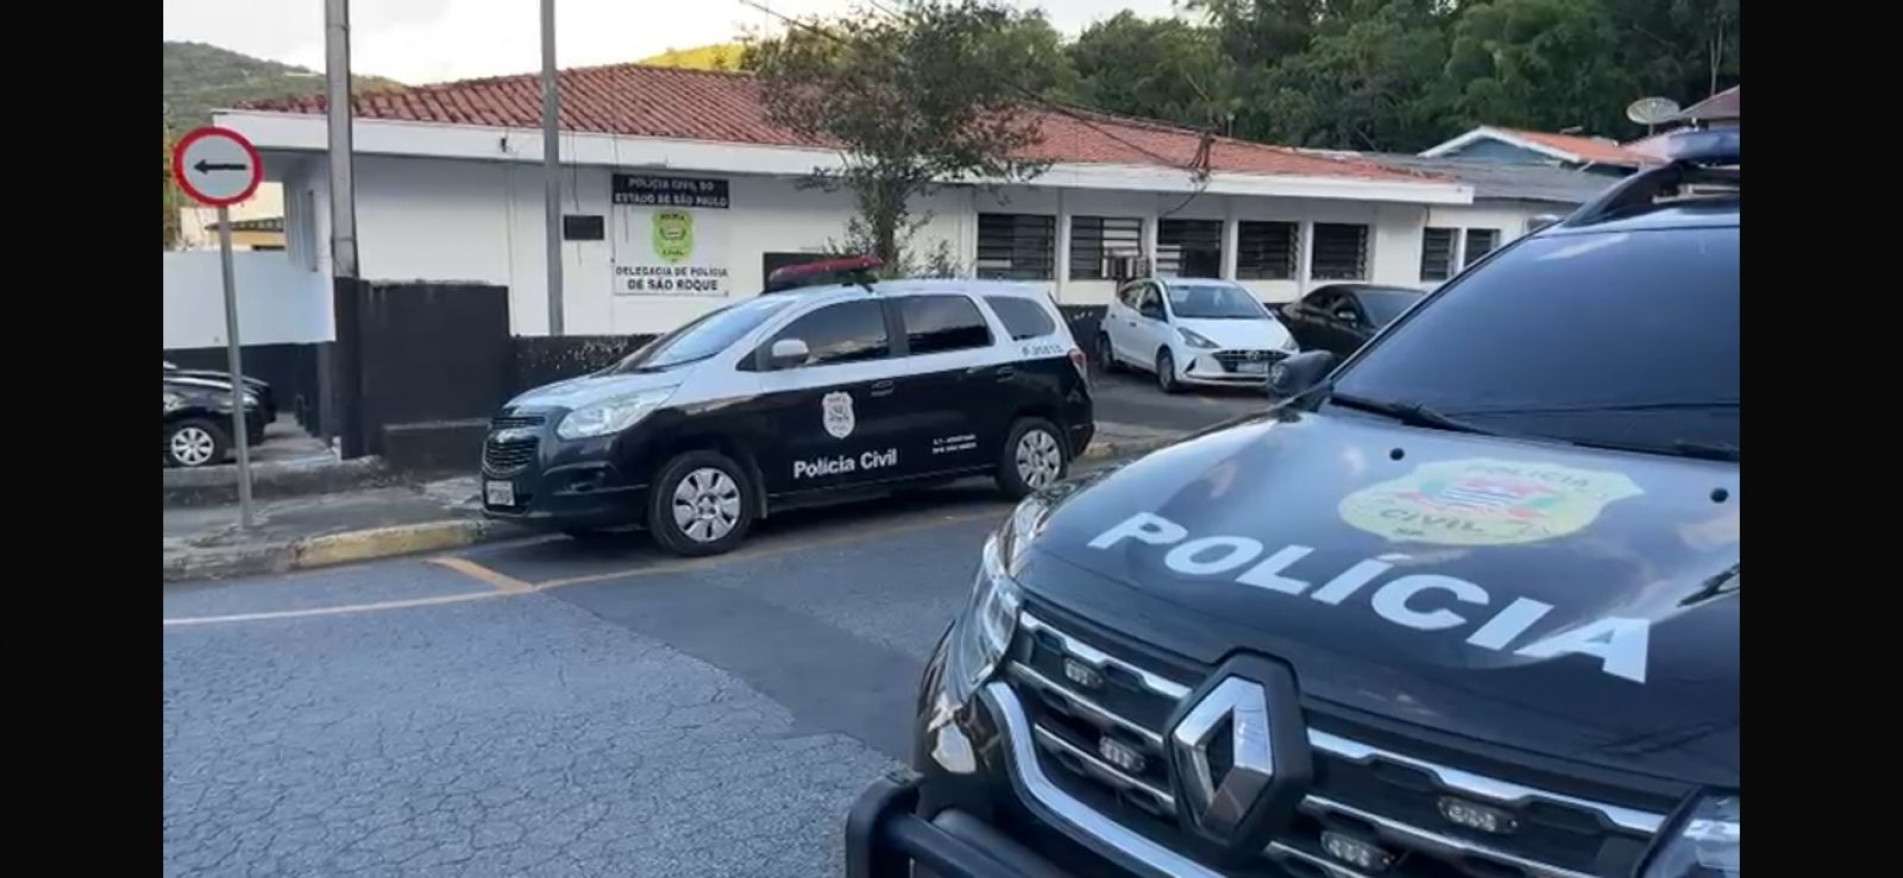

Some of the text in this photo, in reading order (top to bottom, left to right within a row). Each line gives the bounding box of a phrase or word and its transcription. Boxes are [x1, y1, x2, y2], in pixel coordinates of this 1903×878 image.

[615, 265, 673, 277] DELEGACIA
[675, 266, 688, 277] DE
[627, 278, 644, 291] DE
[677, 278, 718, 292] ROQUE
[860, 448, 898, 469] Civil
[1379, 508, 1485, 534] CIVIL
[1088, 510, 1650, 685] POLÍCIA
